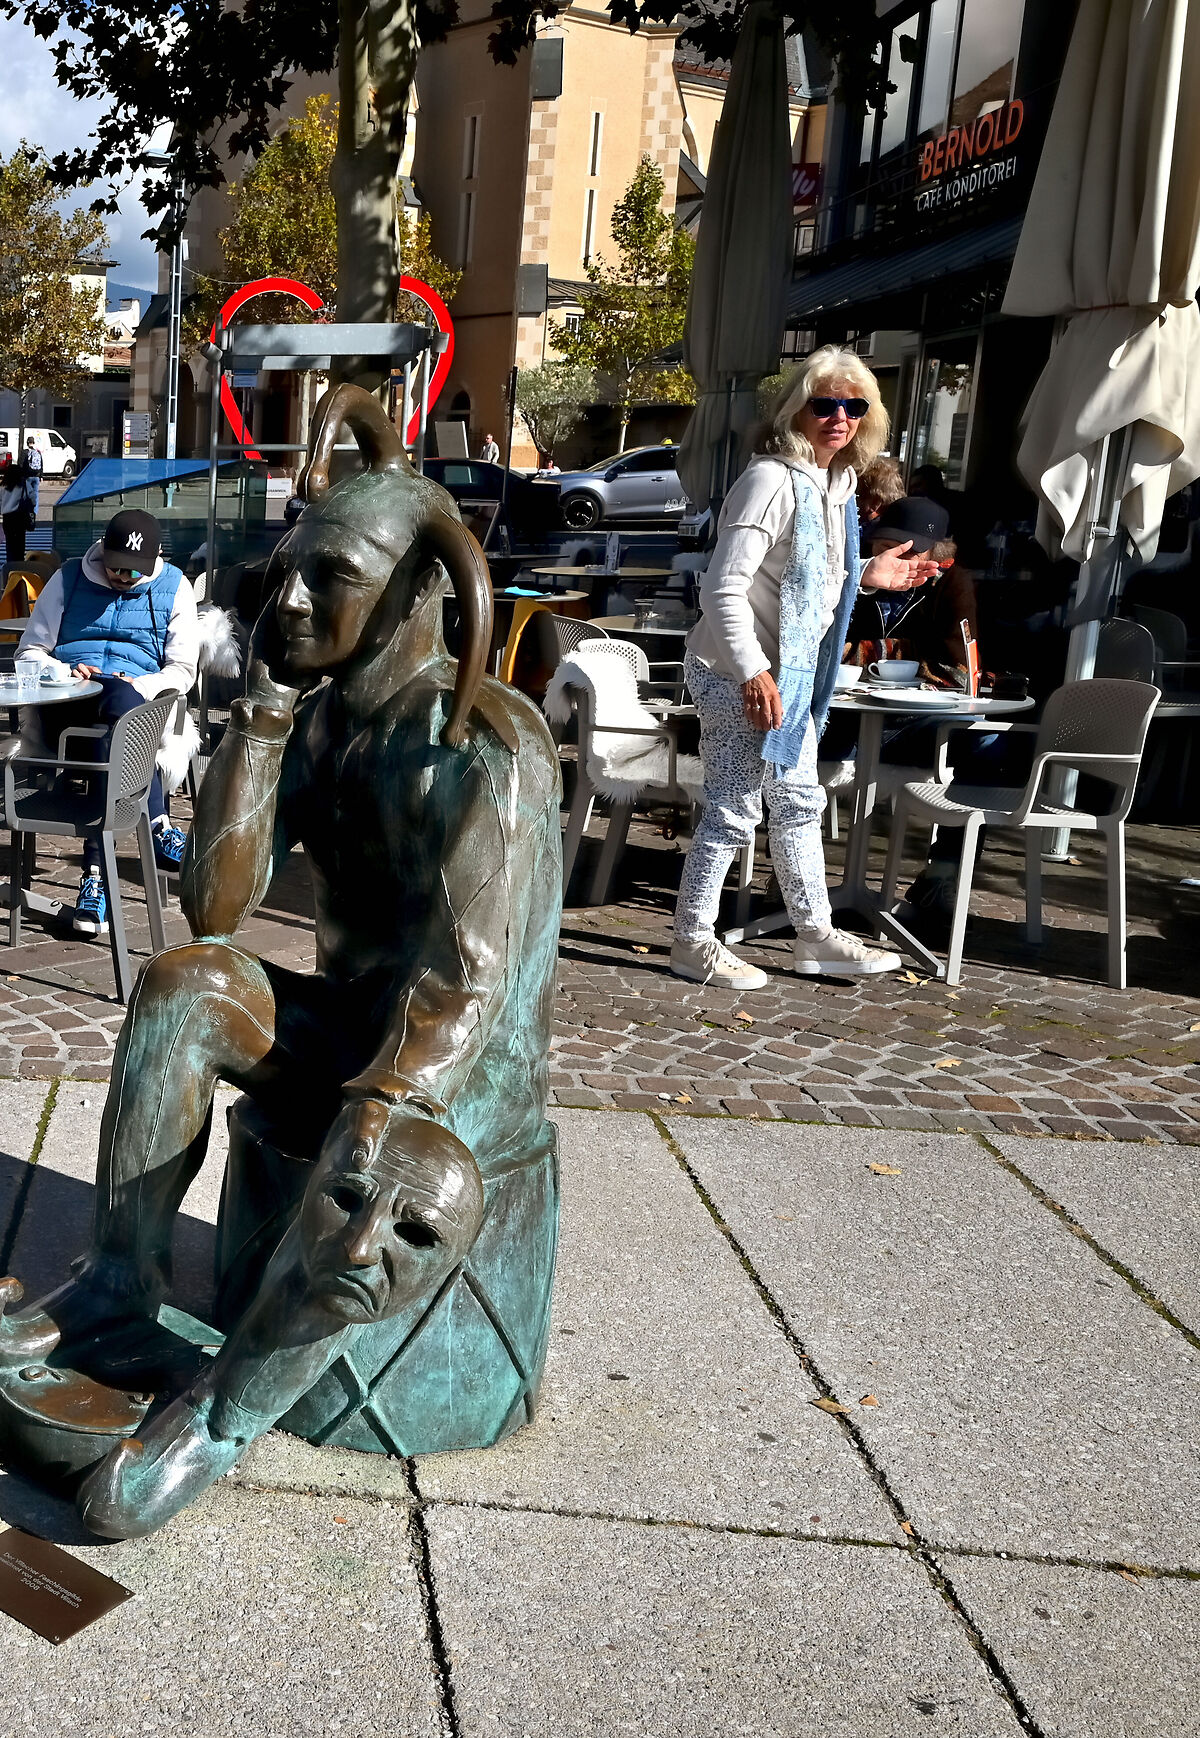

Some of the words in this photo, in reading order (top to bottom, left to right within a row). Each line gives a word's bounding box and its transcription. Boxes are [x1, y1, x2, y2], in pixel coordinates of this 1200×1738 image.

[921, 98, 1024, 181] BERNOLD
[945, 156, 1017, 202] KONDITOREI
[125, 530, 144, 551] NY
[3, 1551, 15, 1561] Der
[15, 1558, 39, 1575] Villacher
[20, 1577, 40, 1591] 2008
[22, 1570, 33, 1580] von
[33, 1578, 44, 1586] der
[44, 1584, 60, 1596] Stadt
[60, 1593, 80, 1609] Villach
